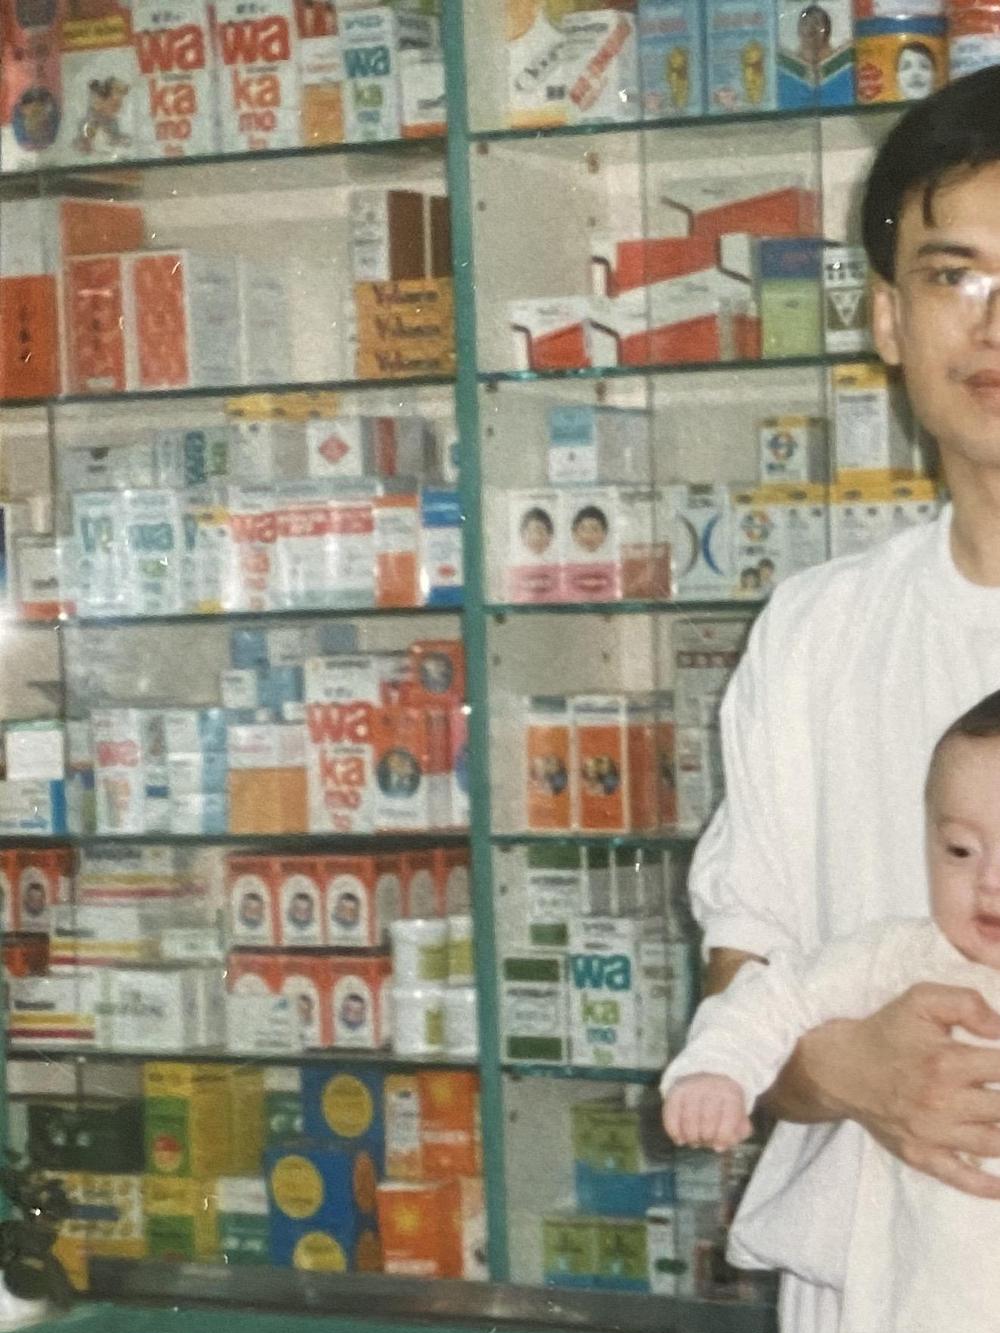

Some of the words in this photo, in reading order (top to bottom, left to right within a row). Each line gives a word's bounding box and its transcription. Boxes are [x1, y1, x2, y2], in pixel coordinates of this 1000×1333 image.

[135, 26, 204, 73] wa
[220, 16, 290, 65] wa
[149, 79, 196, 117] ka
[232, 67, 281, 109] ka
[308, 701, 371, 744] wa
[569, 954, 632, 991] wa
